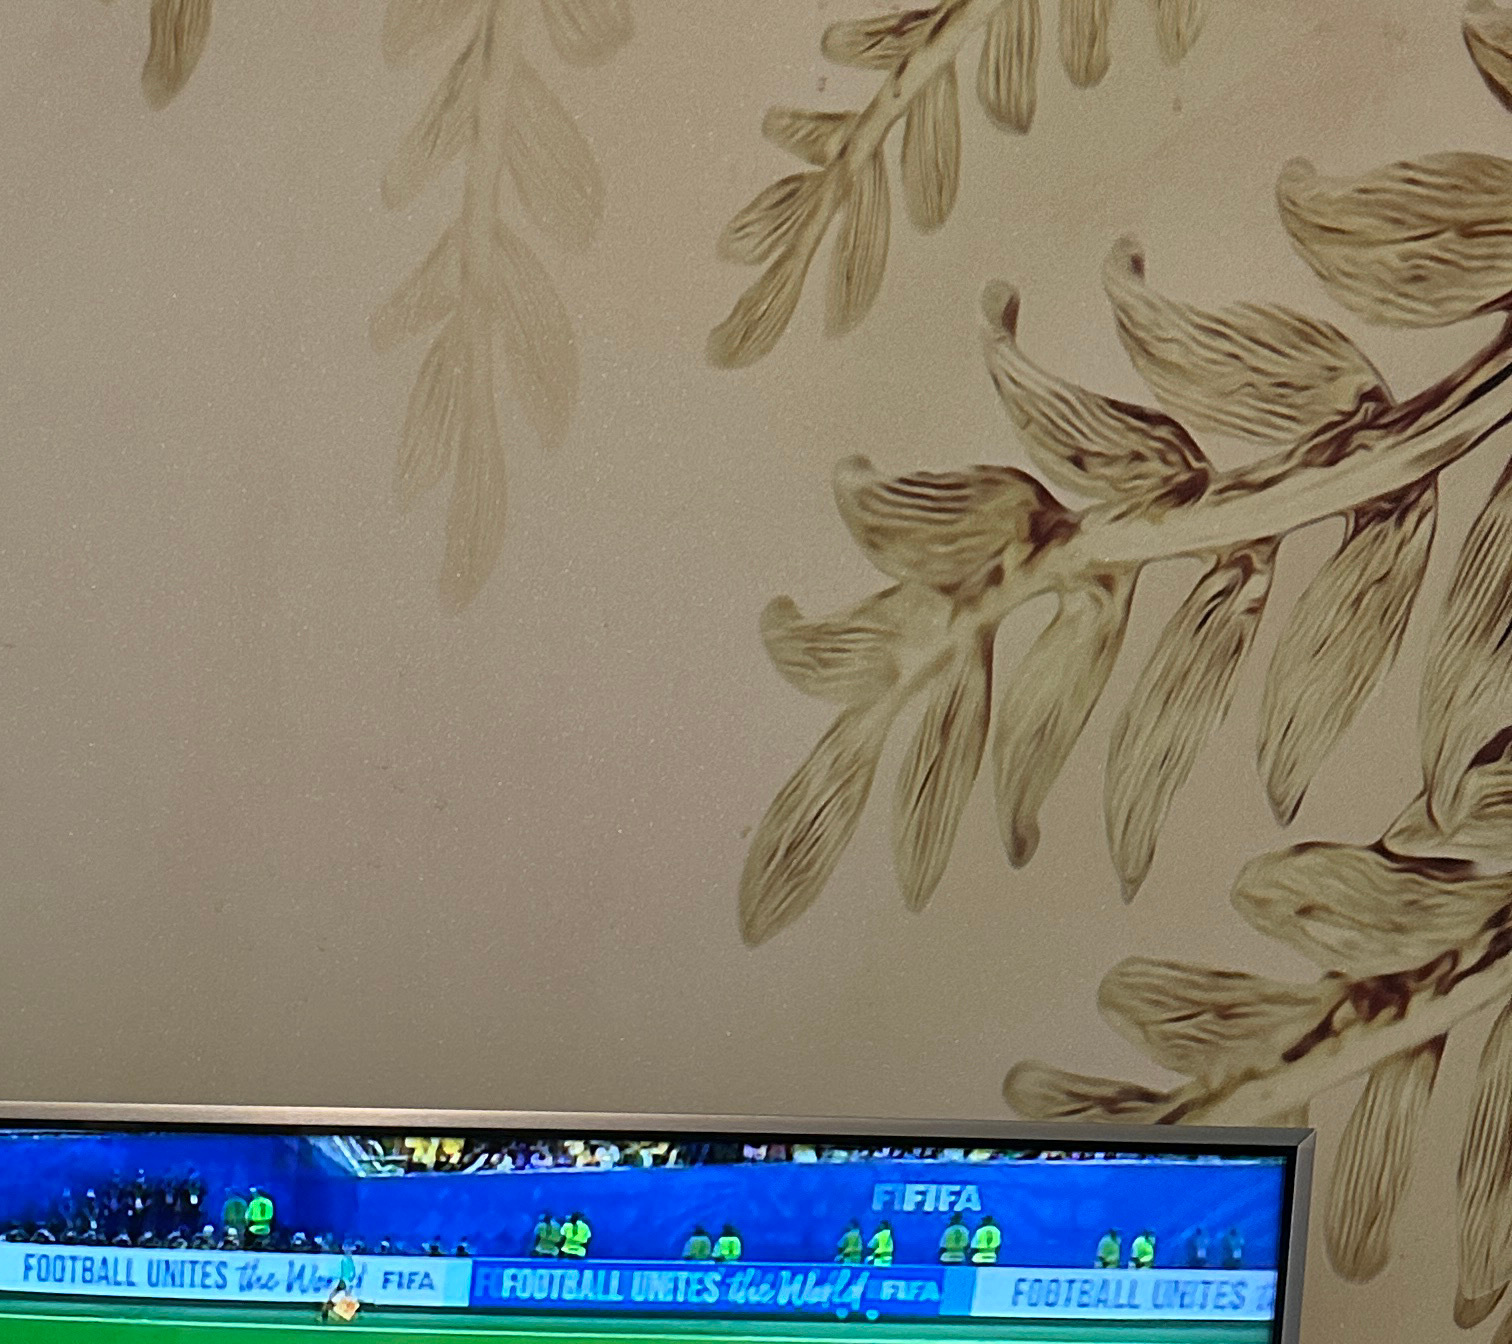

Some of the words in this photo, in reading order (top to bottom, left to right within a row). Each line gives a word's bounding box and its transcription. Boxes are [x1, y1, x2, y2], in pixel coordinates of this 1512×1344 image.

[22, 1252, 137, 1287] FOOTBALL
[146, 1258, 229, 1291] UNITES
[381, 1270, 436, 1291] FIFA
[500, 1267, 625, 1301] FOOTBALL
[879, 1280, 941, 1302] FIFA
[1010, 1277, 1140, 1310] FOOTBALL
